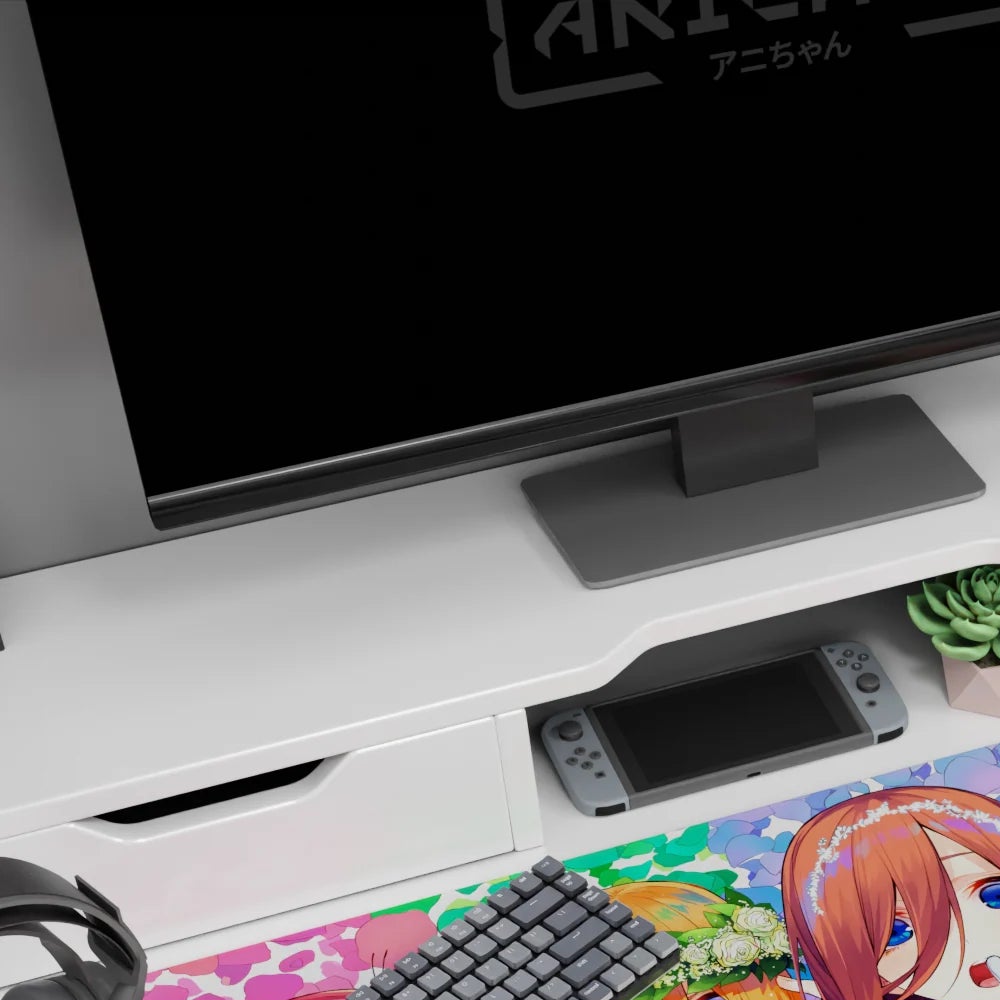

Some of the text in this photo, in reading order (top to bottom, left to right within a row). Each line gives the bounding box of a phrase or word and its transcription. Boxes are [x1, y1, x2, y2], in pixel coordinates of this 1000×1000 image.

[709, 30, 852, 81] アニちゃん
